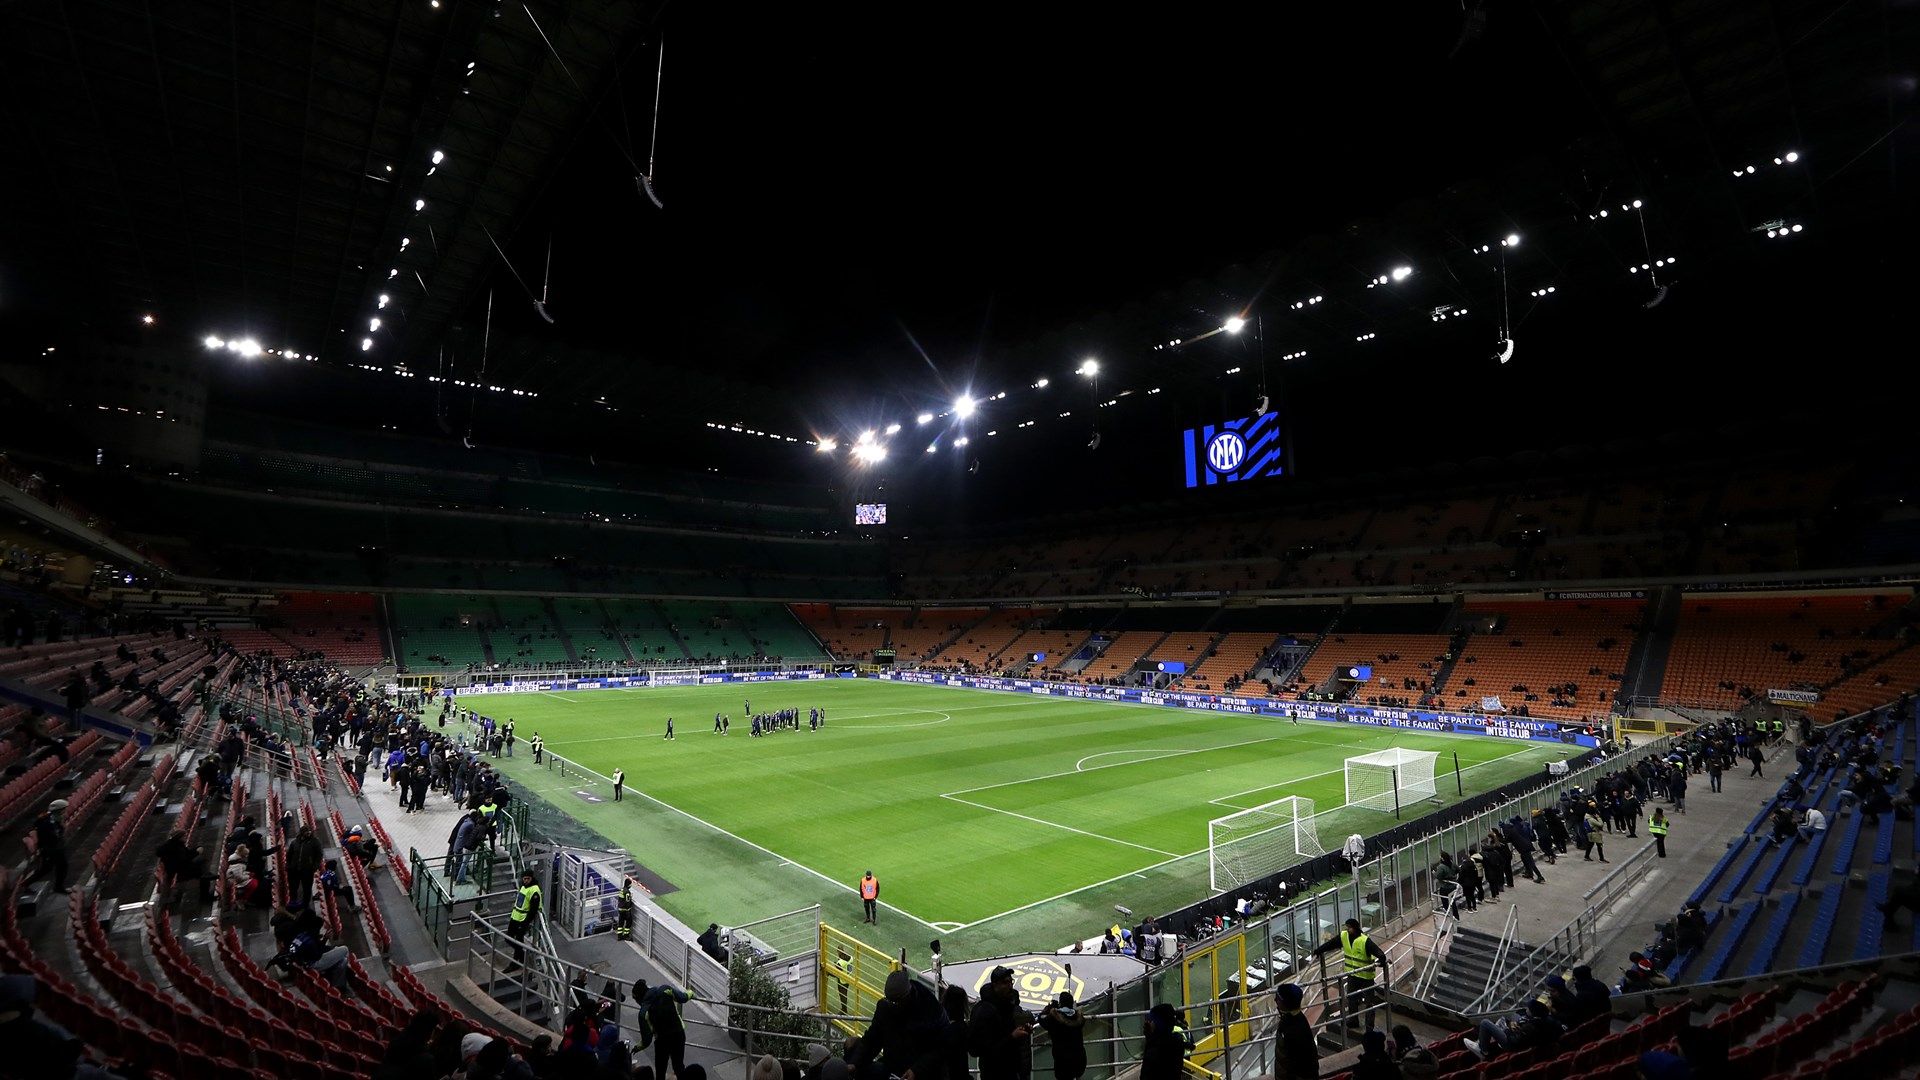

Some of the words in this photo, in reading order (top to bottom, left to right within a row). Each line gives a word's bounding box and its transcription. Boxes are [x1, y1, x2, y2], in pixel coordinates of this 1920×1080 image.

[1302, 710, 1316, 719] CLUB
[1395, 719, 1410, 727] THE
[1413, 721, 1444, 730] FAMILY
[1451, 716, 1472, 725] PART
[1510, 722, 1544, 730] FAMILY
[1486, 726, 1508, 737] INTER
[1510, 728, 1530, 739] CLUB
